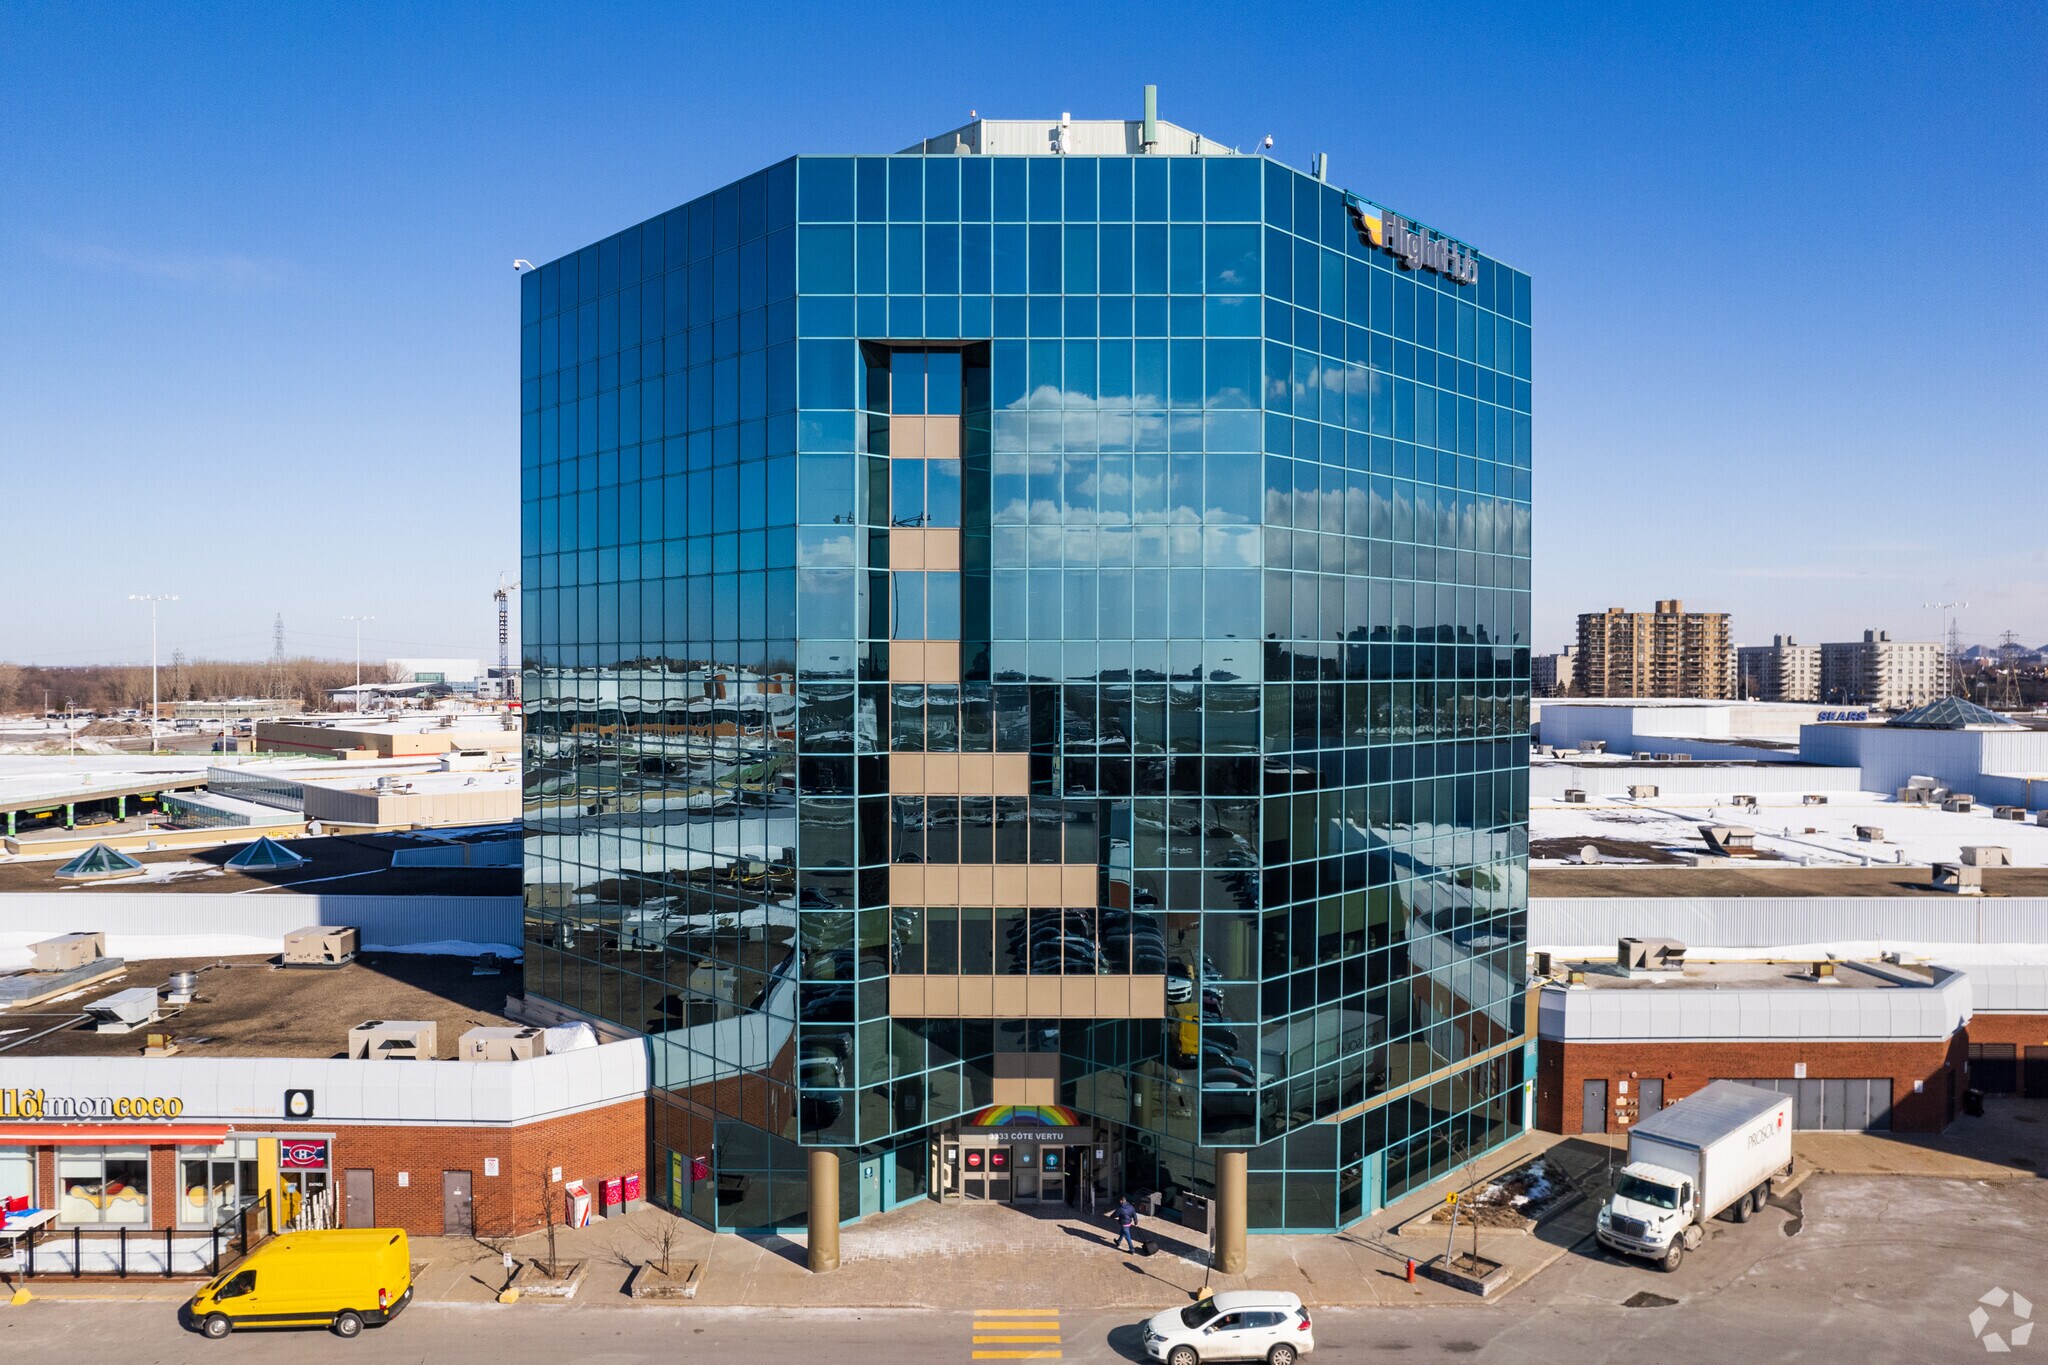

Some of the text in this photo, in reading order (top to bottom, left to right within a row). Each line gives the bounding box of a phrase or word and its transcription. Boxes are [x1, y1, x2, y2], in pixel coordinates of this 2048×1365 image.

[1818, 711, 1867, 721] SEARS
[989, 1132, 1064, 1140] 3333 CÔTE VERTU
[1747, 1121, 1775, 1150] PROSOL
